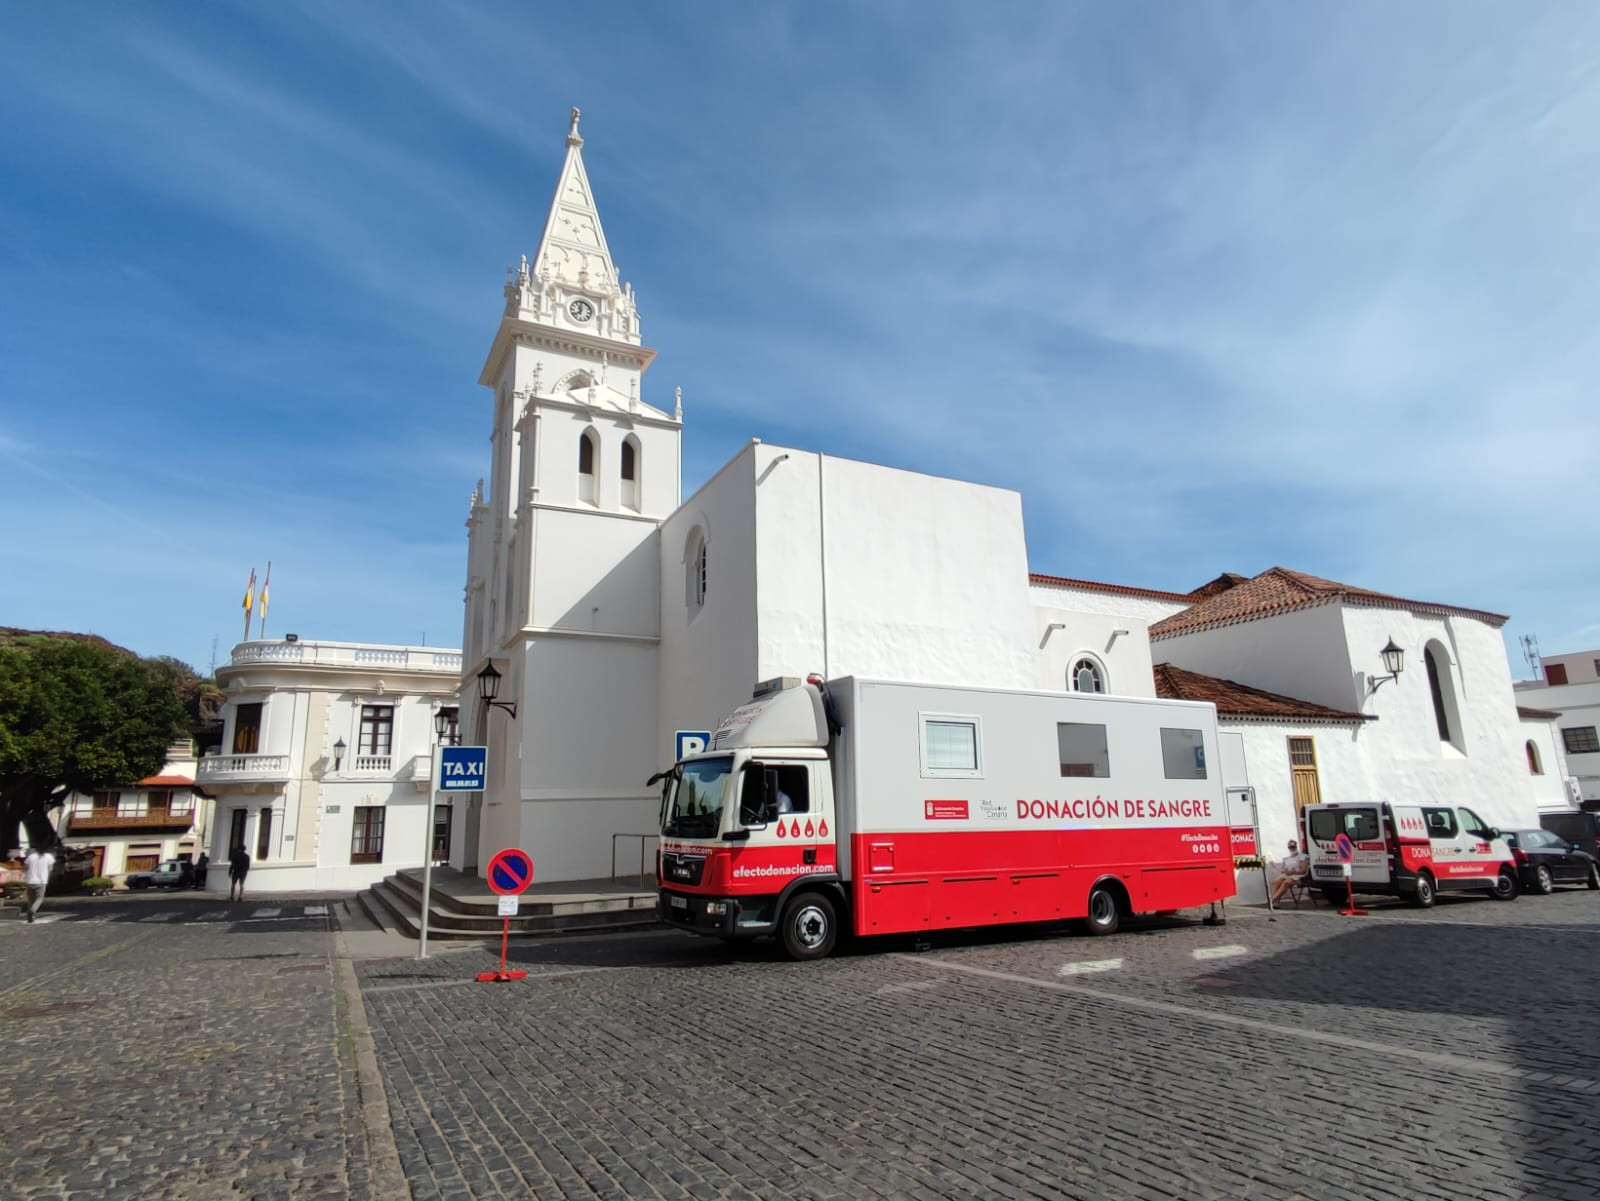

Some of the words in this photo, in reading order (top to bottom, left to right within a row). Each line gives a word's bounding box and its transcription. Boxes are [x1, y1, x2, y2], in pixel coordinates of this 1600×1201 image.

[443, 762, 484, 776] TAXI
[1016, 795, 1120, 819] DONACIÓN
[1124, 799, 1145, 818] DE
[1149, 799, 1212, 818] SANGRE
[1411, 847, 1431, 858] DONA
[733, 864, 834, 877] efectodonacion.com
